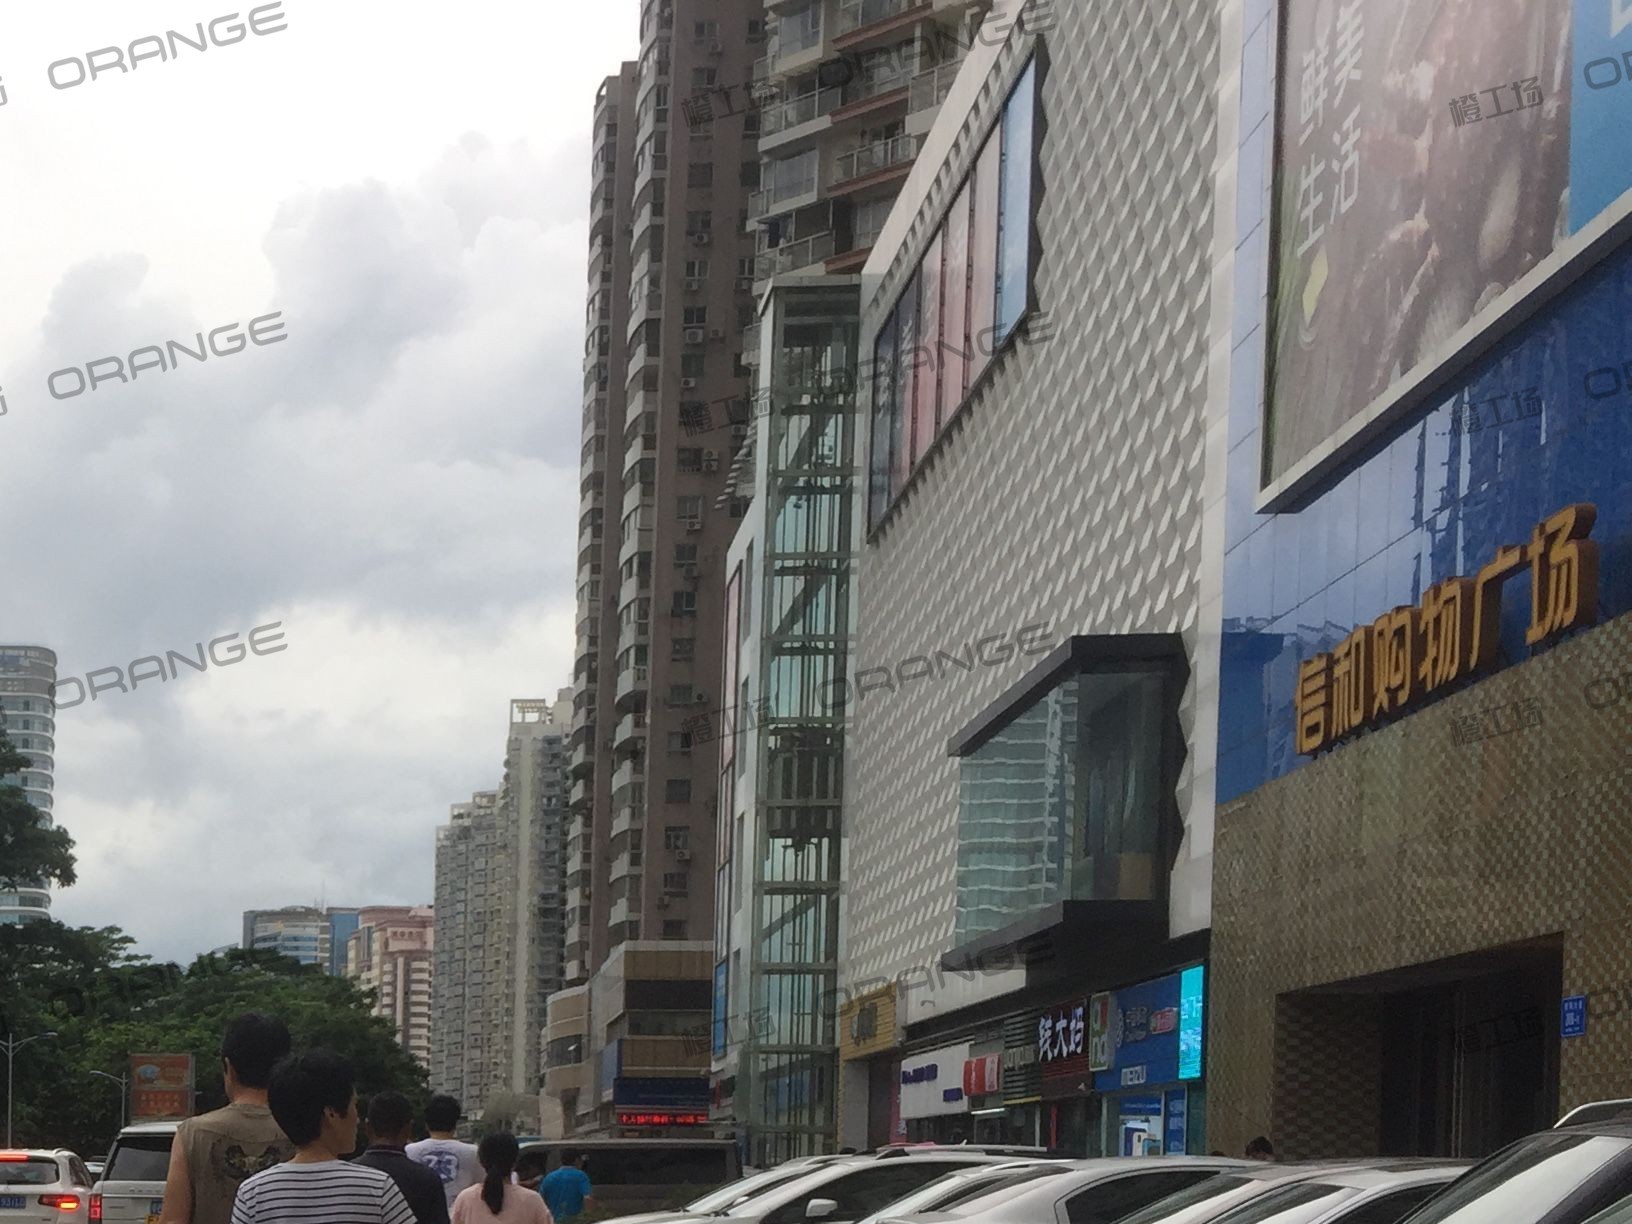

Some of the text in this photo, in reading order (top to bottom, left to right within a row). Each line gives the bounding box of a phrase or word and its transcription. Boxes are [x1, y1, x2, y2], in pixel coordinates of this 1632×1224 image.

[1294, 502, 1598, 756] 信和购物广场
[1039, 1006, 1084, 1062] 钱大妈
